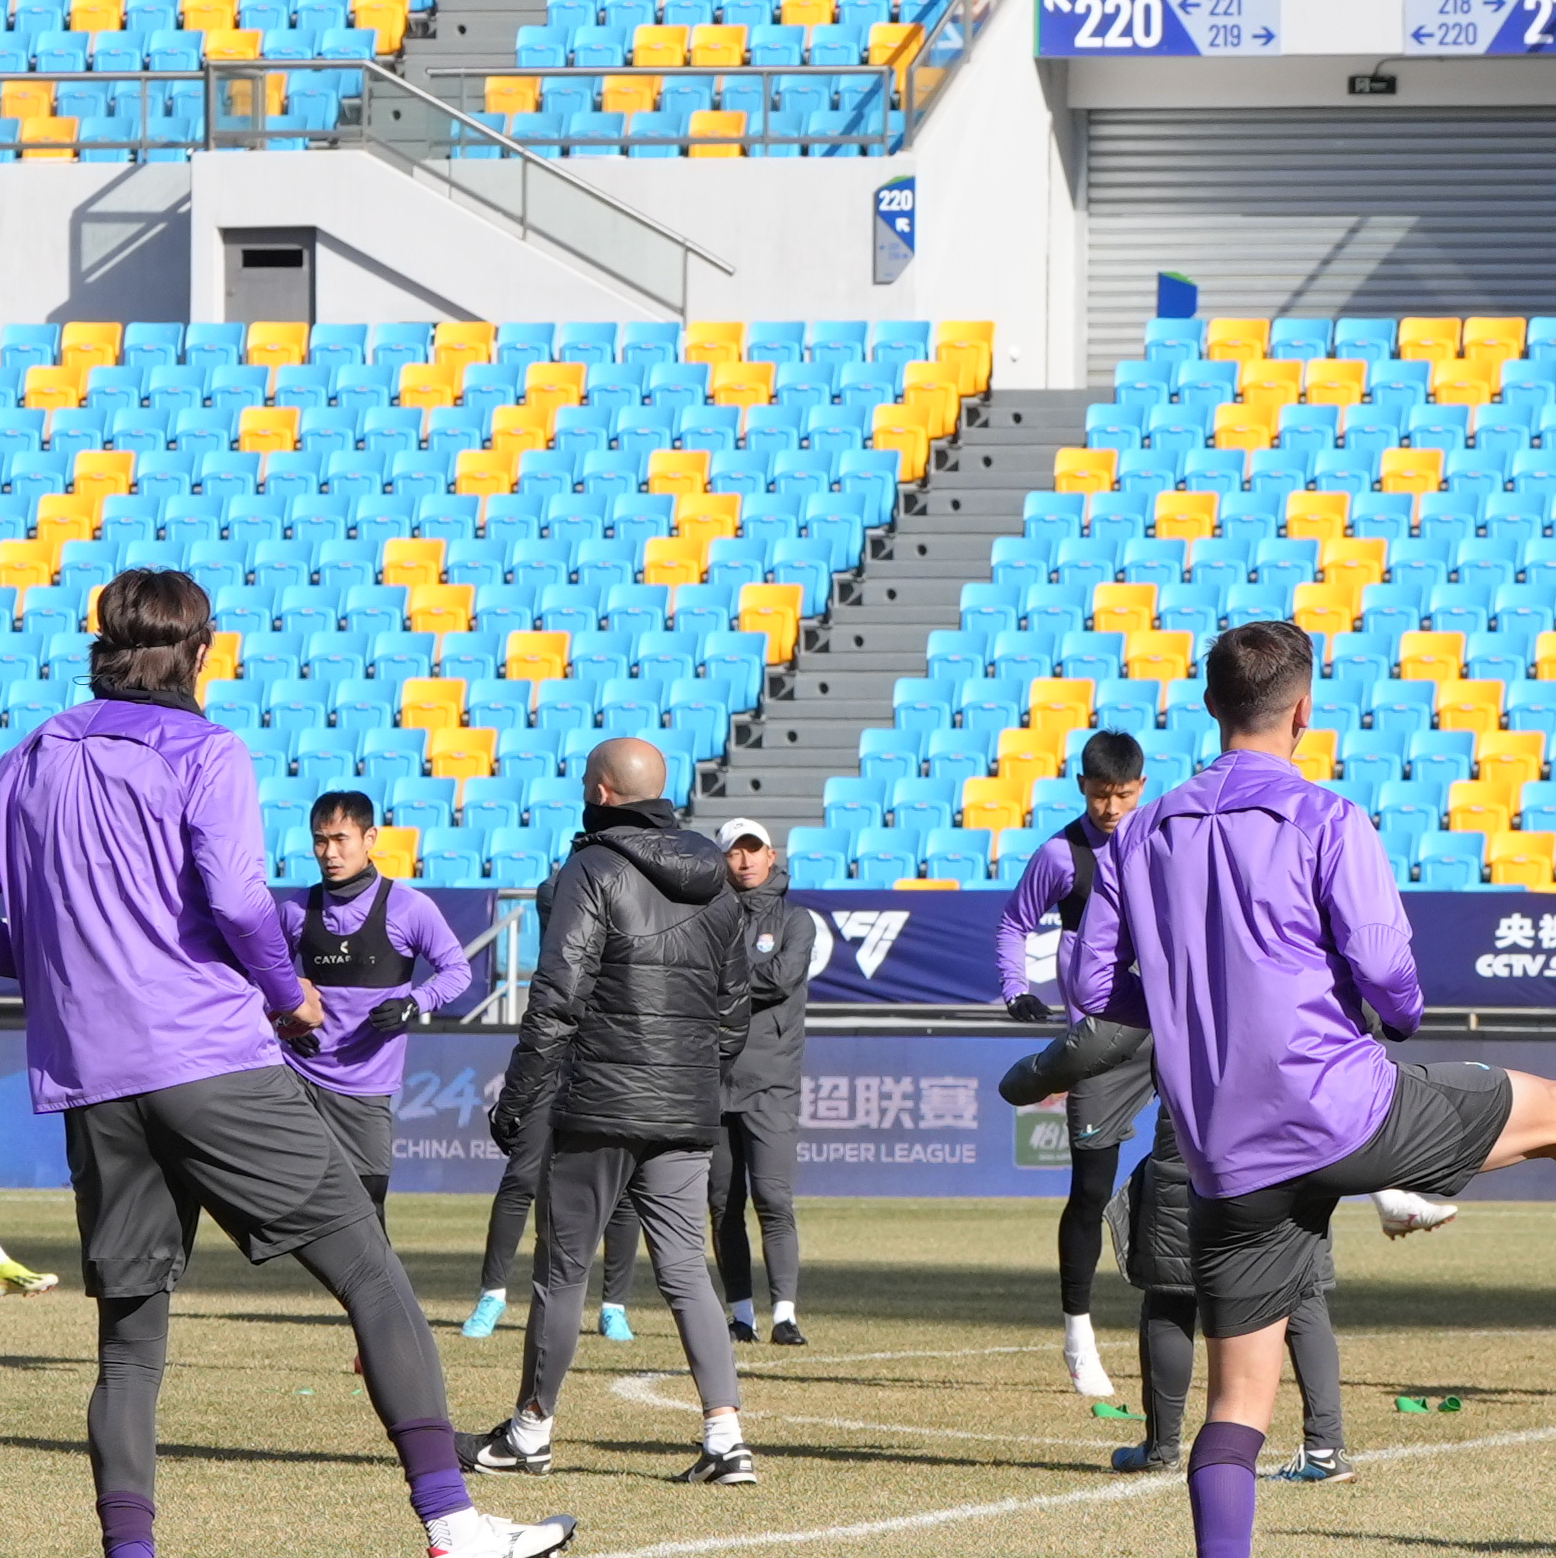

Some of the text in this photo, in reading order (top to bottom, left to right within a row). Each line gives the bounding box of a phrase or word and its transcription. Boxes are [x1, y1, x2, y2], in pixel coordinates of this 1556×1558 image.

[1208, 24, 1242, 48] 219
[1437, 22, 1478, 47] 220
[878, 188, 914, 212] 220
[1475, 953, 1546, 978] CCTV
[392, 1138, 466, 1159] CHINA
[796, 1143, 977, 1164] SUPER LEAGUE
